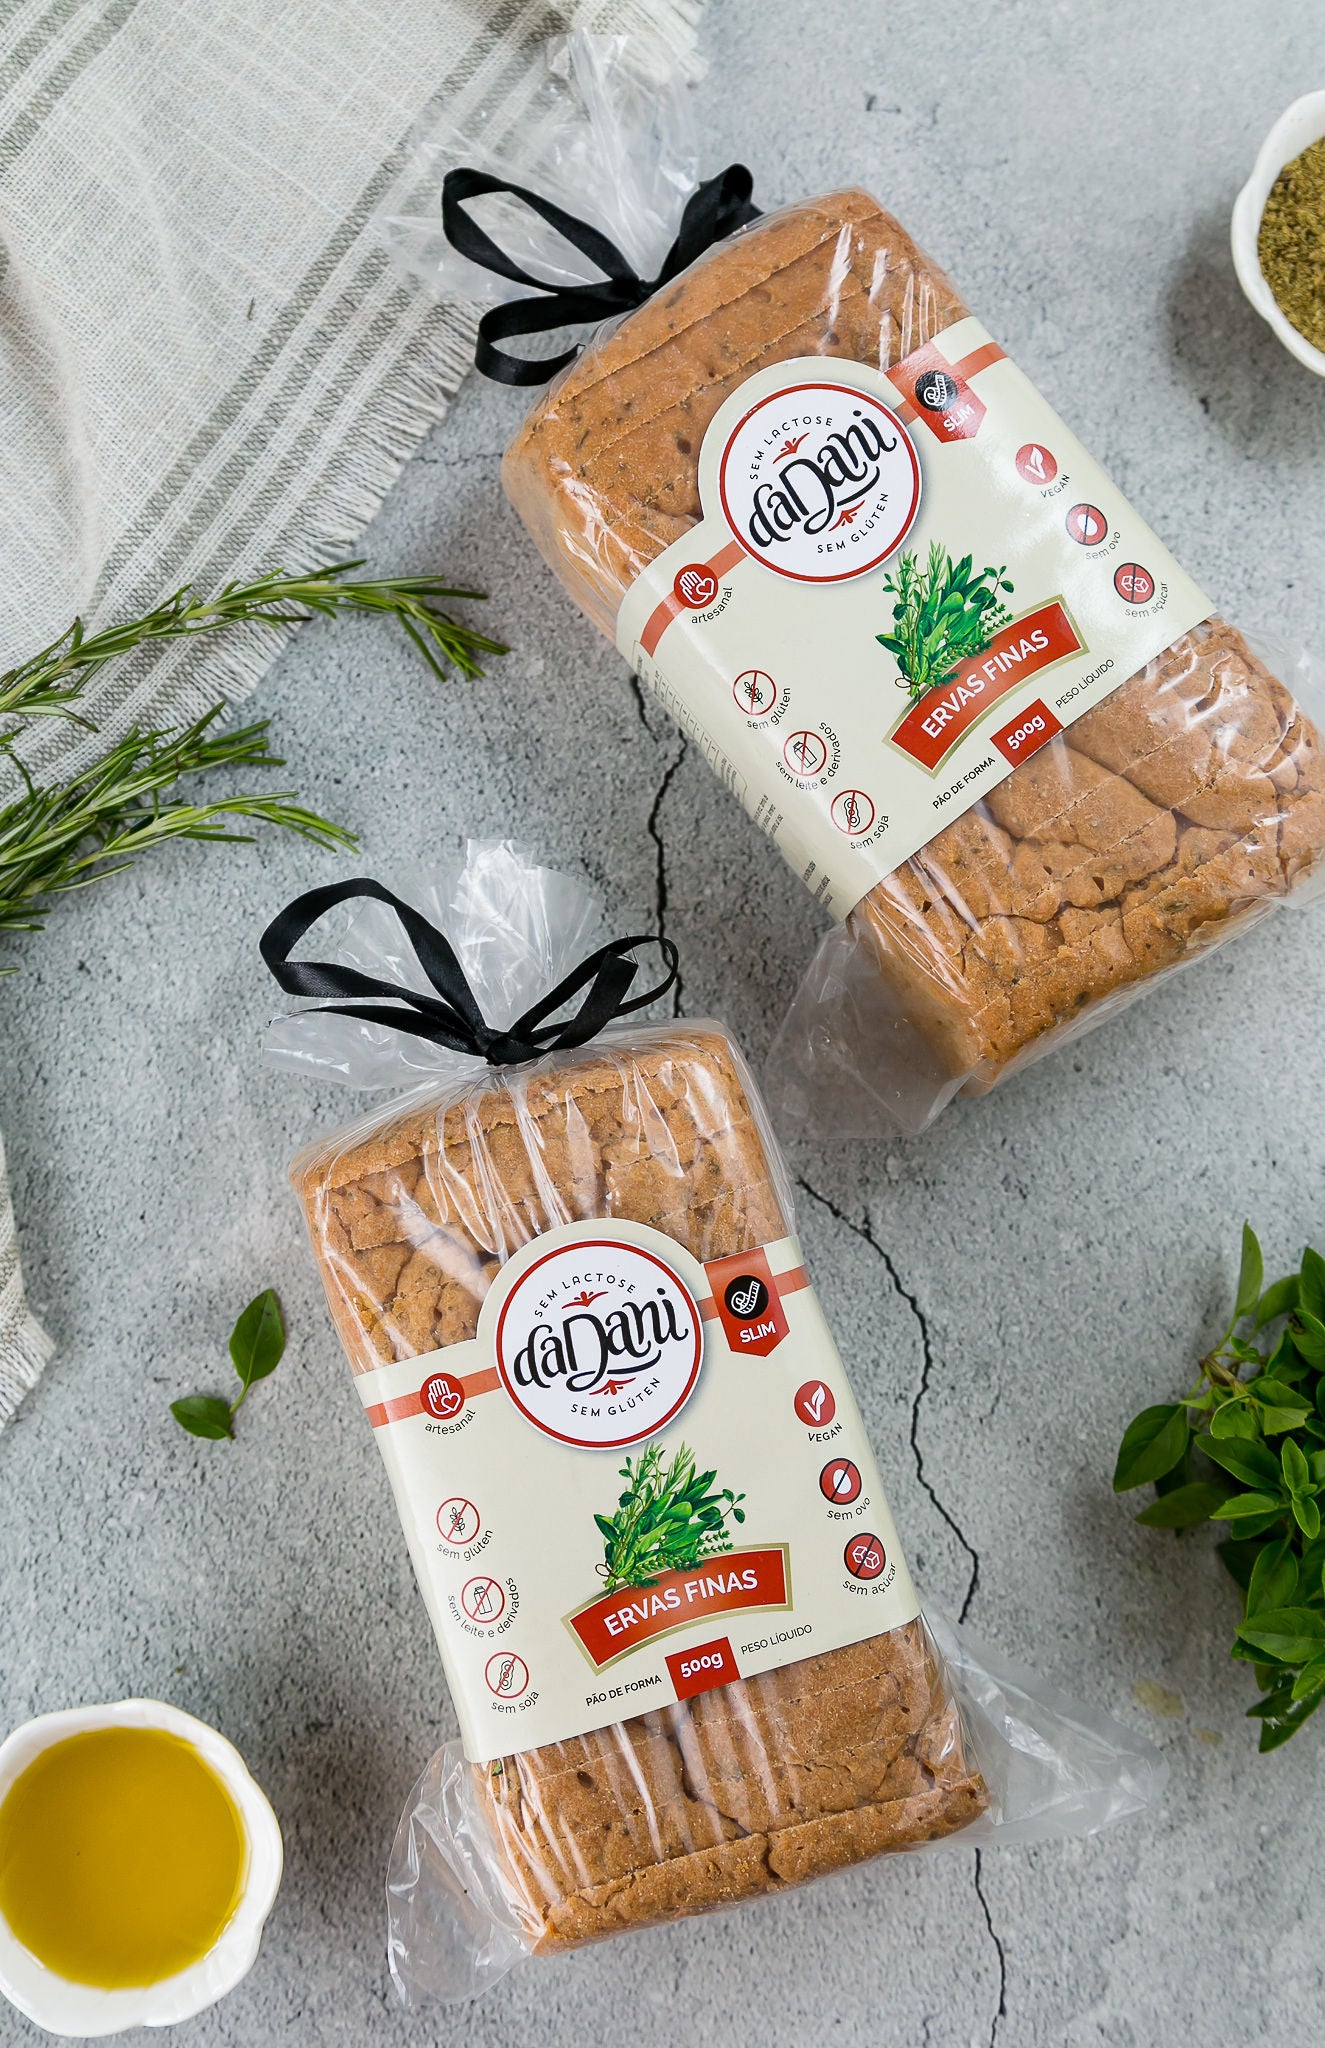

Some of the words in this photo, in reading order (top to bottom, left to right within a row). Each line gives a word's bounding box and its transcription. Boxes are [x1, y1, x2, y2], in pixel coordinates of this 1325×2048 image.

[943, 404, 975, 433] SLIM
[750, 450, 765, 480] SEM
[763, 416, 834, 448] LACTOSE
[1040, 474, 1071, 498] VEGAN
[817, 538, 847, 554] SEM
[850, 492, 890, 546] GLÚTEN
[1086, 548, 1109, 560] sem
[1108, 531, 1121, 549] ovo
[691, 586, 732, 625] artesanal
[1124, 606, 1150, 618] sem
[1151, 581, 1168, 614] açúcar
[921, 674, 988, 740] ERVAS
[983, 630, 1050, 684] FINAS
[1055, 684, 1081, 708] PESO
[1075, 659, 1114, 690] LÍQUIDO
[746, 718, 770, 731] sem
[770, 688, 791, 726] glúten
[1007, 714, 1046, 750] 500g
[819, 722, 841, 778] derivados
[776, 760, 794, 783] sem
[795, 776, 818, 790] leite
[820, 776, 828, 785] e
[933, 788, 954, 810] PÃO
[951, 782, 964, 796] DE
[962, 756, 996, 786] FORMA
[850, 838, 874, 850] sem
[874, 815, 890, 839] soja
[533, 1288, 558, 1318] SEM
[562, 1273, 636, 1294] LACTOSE
[739, 1322, 777, 1343] SLIM
[570, 1403, 601, 1417] SEM
[607, 1377, 661, 1416] GLÚTEN
[425, 1409, 475, 1435] artesanal
[808, 1423, 844, 1443] VEGAN
[826, 1510, 853, 1522] sem
[855, 1497, 870, 1516] ovo
[436, 1542, 461, 1560] sem
[463, 1529, 494, 1562] glúten
[842, 1579, 867, 1596] sem
[872, 1562, 896, 1595] açúcar
[447, 1595, 461, 1623] sem
[460, 1620, 485, 1639] leite
[487, 1628, 495, 1637] e
[496, 1577, 520, 1635] derivados
[603, 1588, 681, 1638] ERVAS
[685, 1569, 758, 1605] FINAS
[741, 1637, 769, 1655] PESO
[769, 1624, 813, 1647] LÍQUIDO
[680, 1651, 724, 1681] 500g
[491, 1700, 516, 1714] sem
[519, 1690, 540, 1712] soja
[585, 1690, 607, 1707] PÃO
[608, 1686, 623, 1699] DE
[624, 1674, 663, 1696] FORMA
